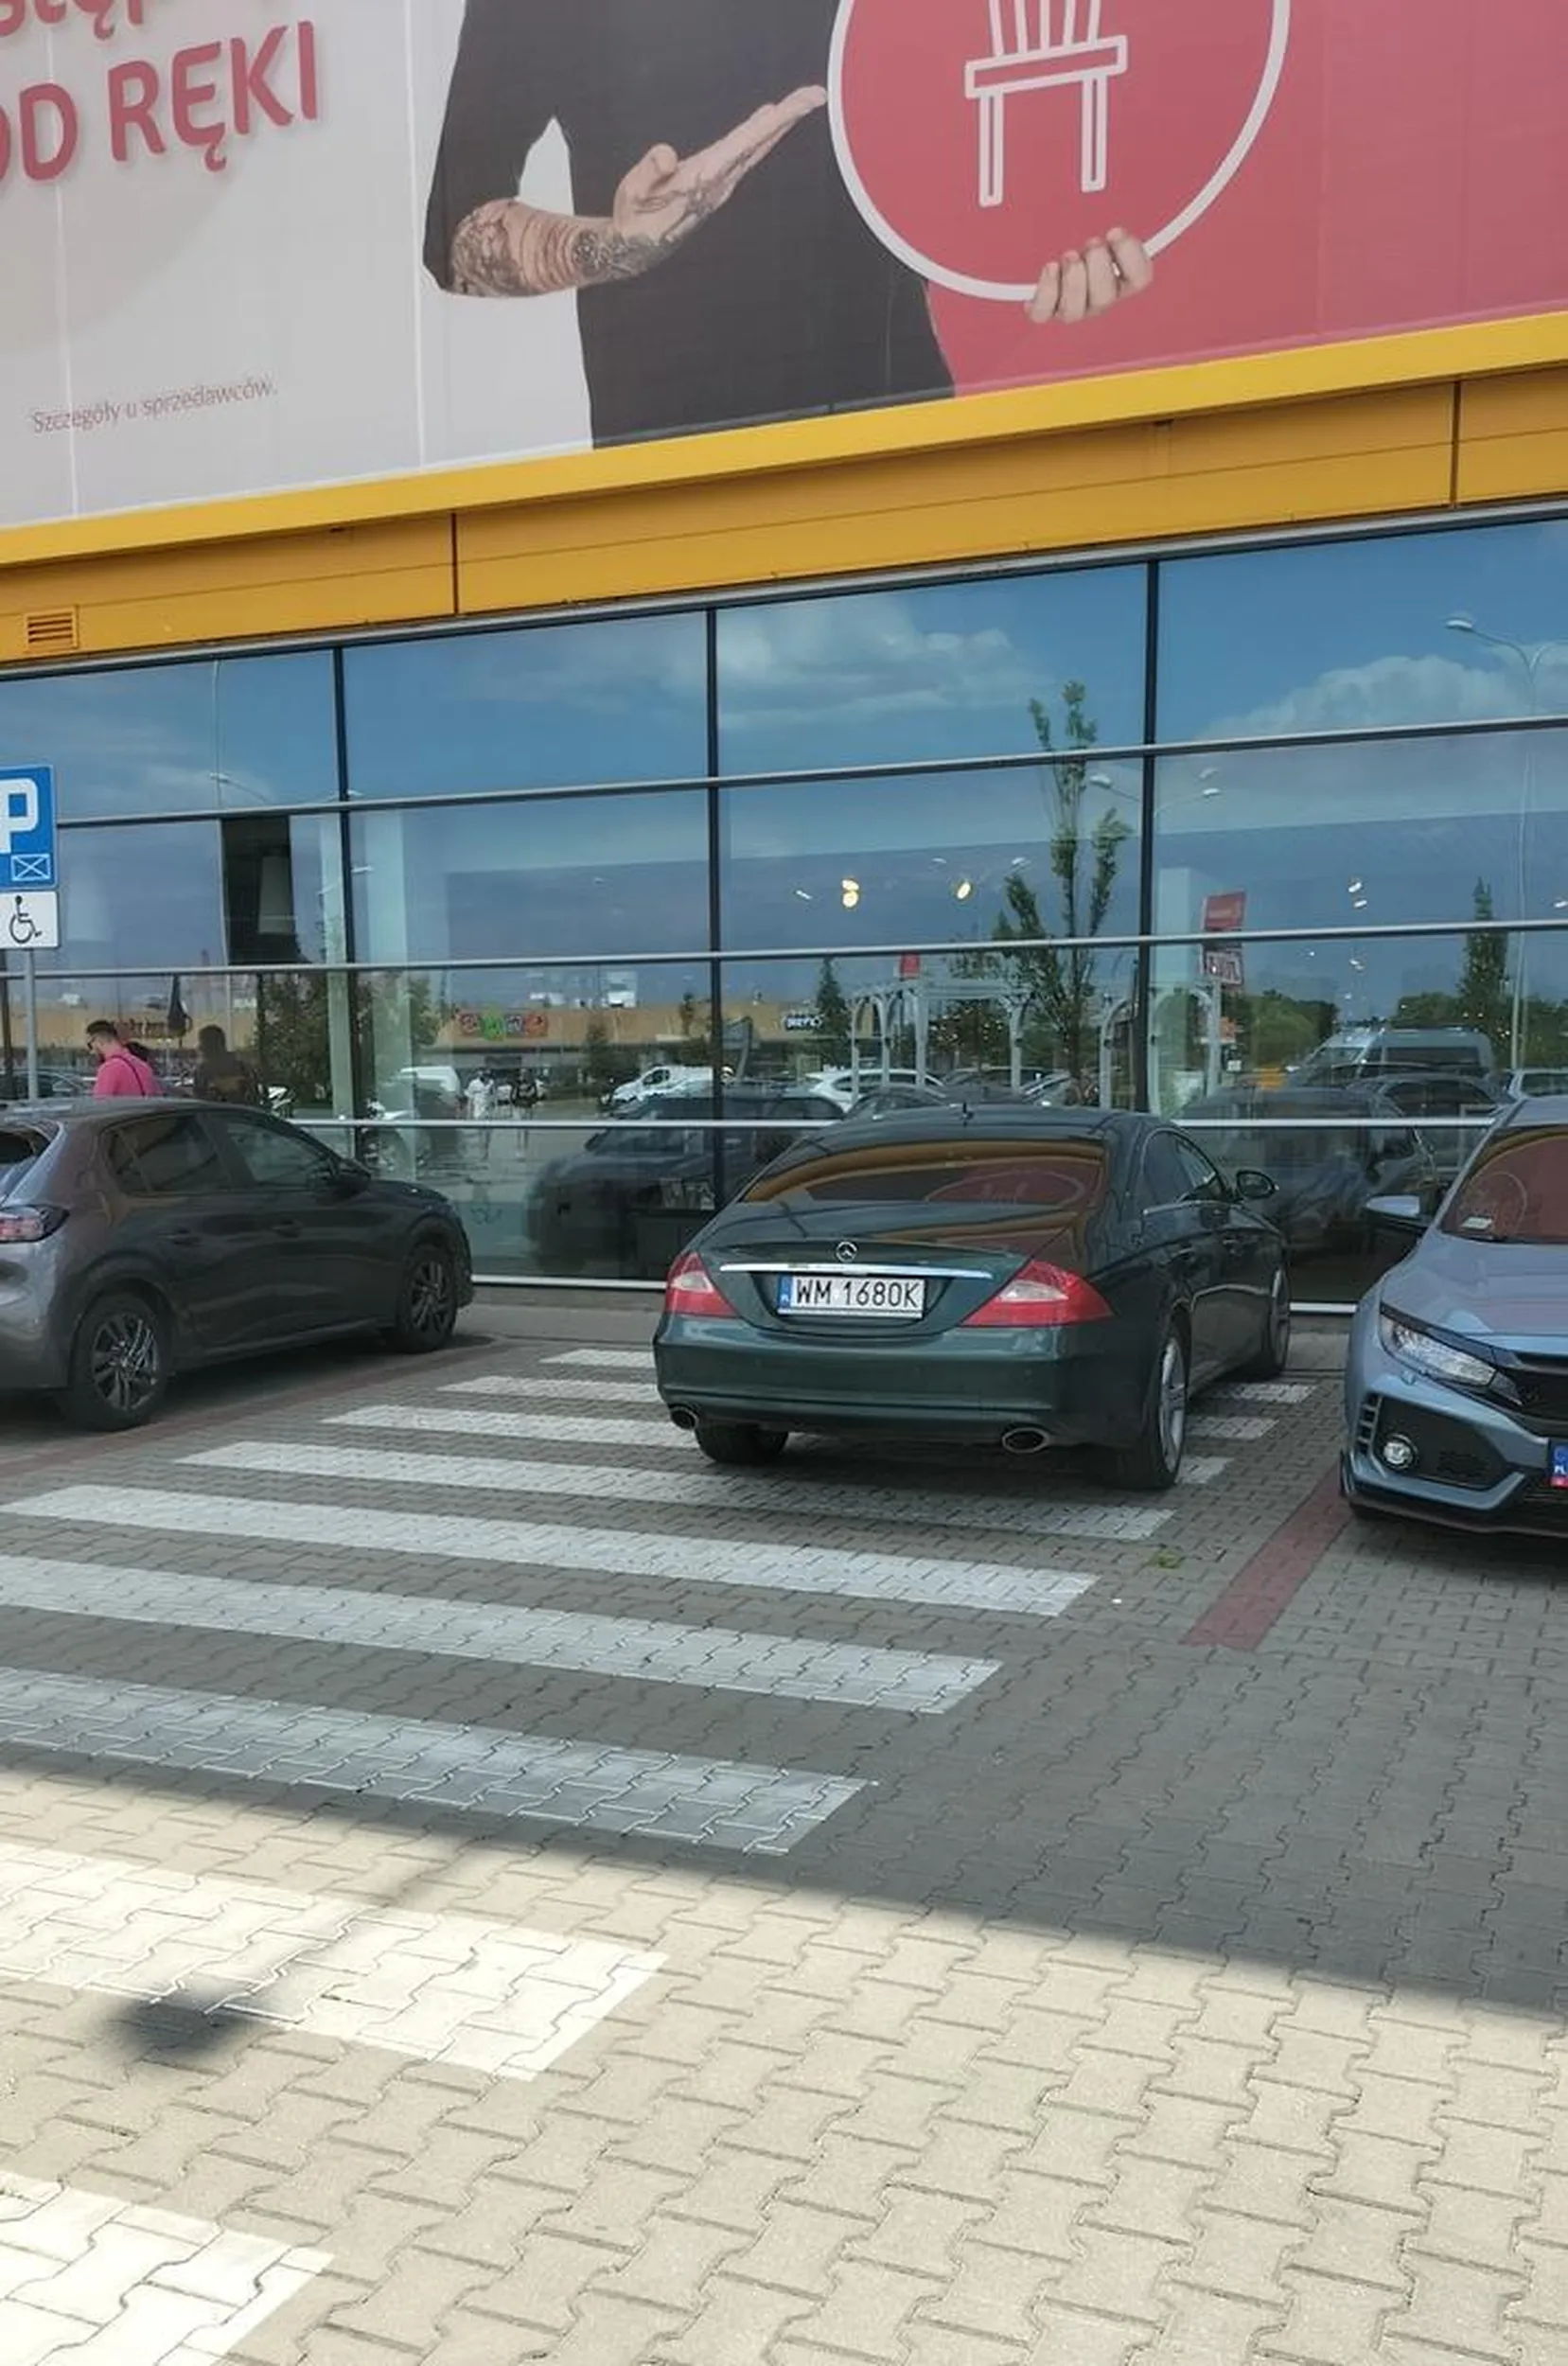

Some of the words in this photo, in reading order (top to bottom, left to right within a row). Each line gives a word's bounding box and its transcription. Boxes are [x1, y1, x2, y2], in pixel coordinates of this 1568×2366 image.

[0, 83, 78, 183] D
[108, 21, 318, 172] RĘKI
[126, 401, 138, 419] u
[0, 778, 39, 855] P
[797, 1280, 832, 1304] WM
[843, 1280, 919, 1308] 1680K
